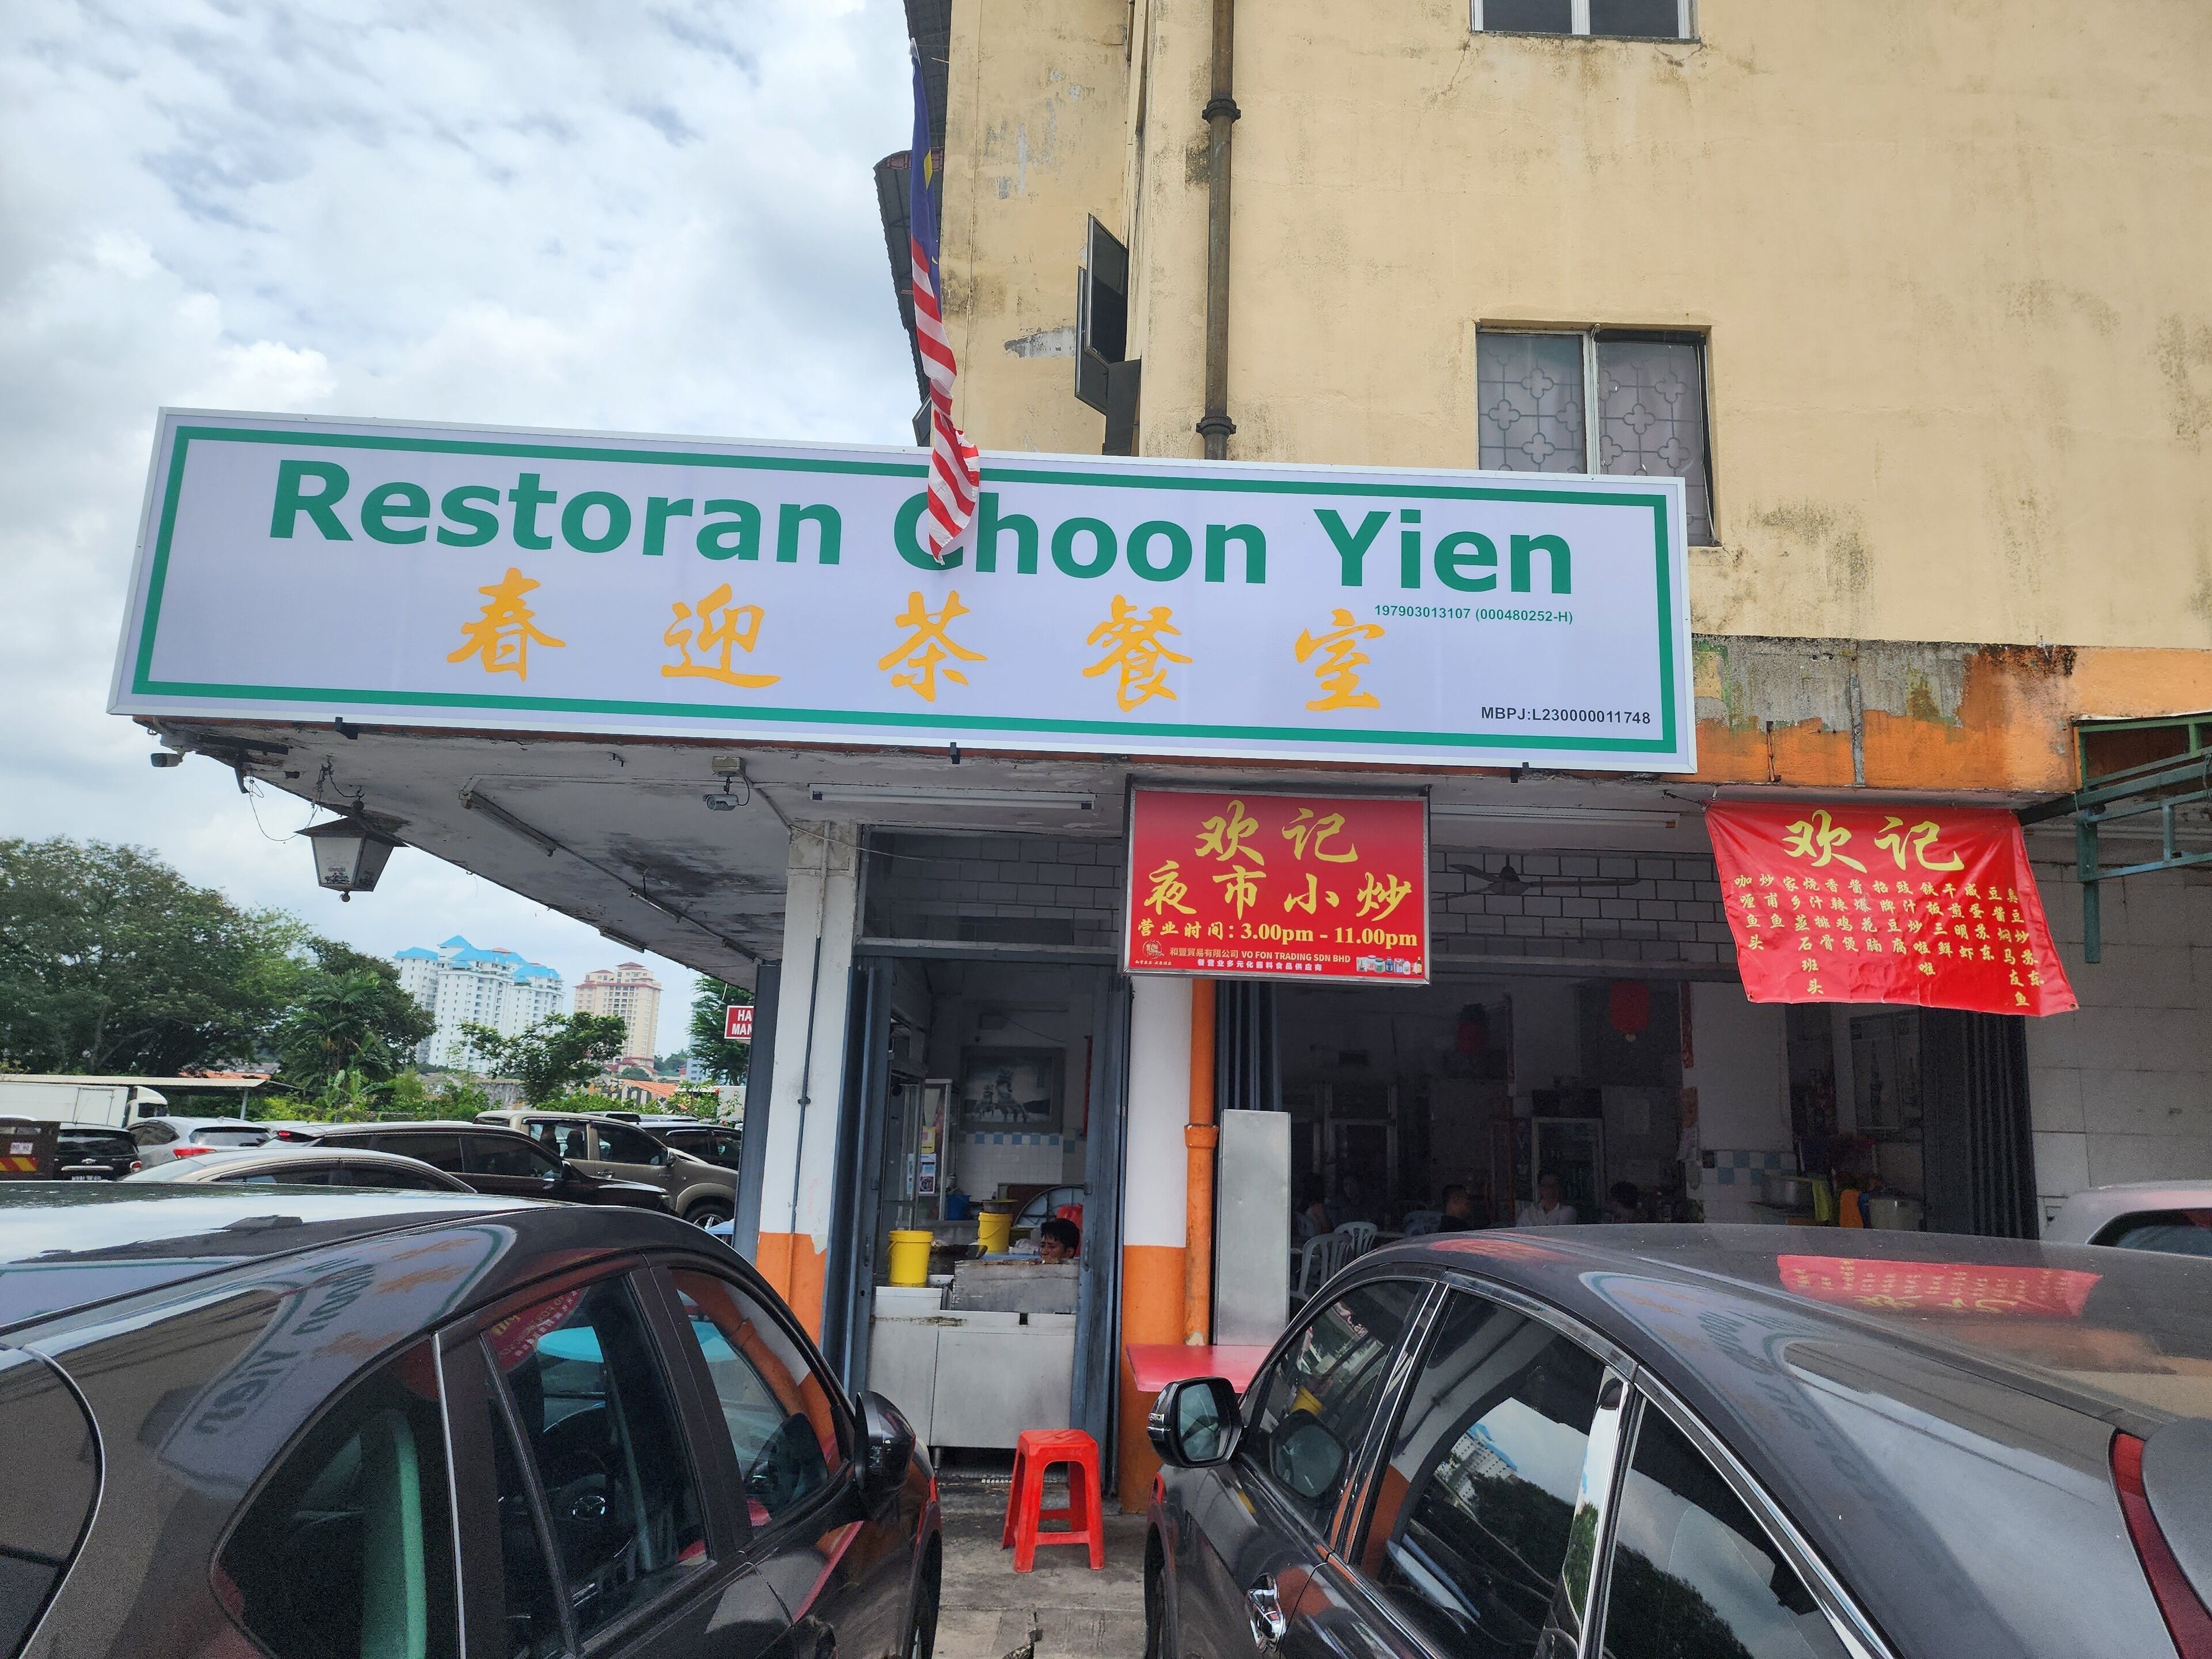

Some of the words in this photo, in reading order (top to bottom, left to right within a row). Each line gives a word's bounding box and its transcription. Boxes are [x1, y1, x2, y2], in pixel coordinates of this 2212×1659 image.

[269, 459, 842, 565] Restoran
[894, 491, 1266, 584] Choon
[1313, 509, 1571, 594] Yien
[446, 567, 1385, 712] 春迎茶餐室
[1374, 604, 1471, 619] 197903013107
[1475, 608, 1573, 625] (000480252-H)
[1481, 706, 1651, 724] MBPJ:L230000011748
[1194, 800, 1358, 866] 欢记
[1782, 809, 1965, 874] 欢记
[1144, 859, 1412, 922] 夜市小炒
[1734, 874, 1764, 950] 咖喱鱼头
[1803, 877, 1835, 952] 烧汁排骨
[1825, 878, 1859, 952] 香辣鸡煲
[1873, 880, 1907, 955] 招牌豆腐
[1919, 882, 1953, 958] 铁板三鲜
[1942, 882, 1975, 961] 干煎明虾
[1964, 882, 1995, 961] 咸蛋苏东
[1241, 950, 1253, 959] VO
[1255, 951, 1272, 960] FON
[1274, 952, 1312, 961] TRADING
[1313, 954, 1330, 962] SDN
[1333, 955, 1351, 963] BHD
[1334, 927, 1418, 949] 11.00pm
